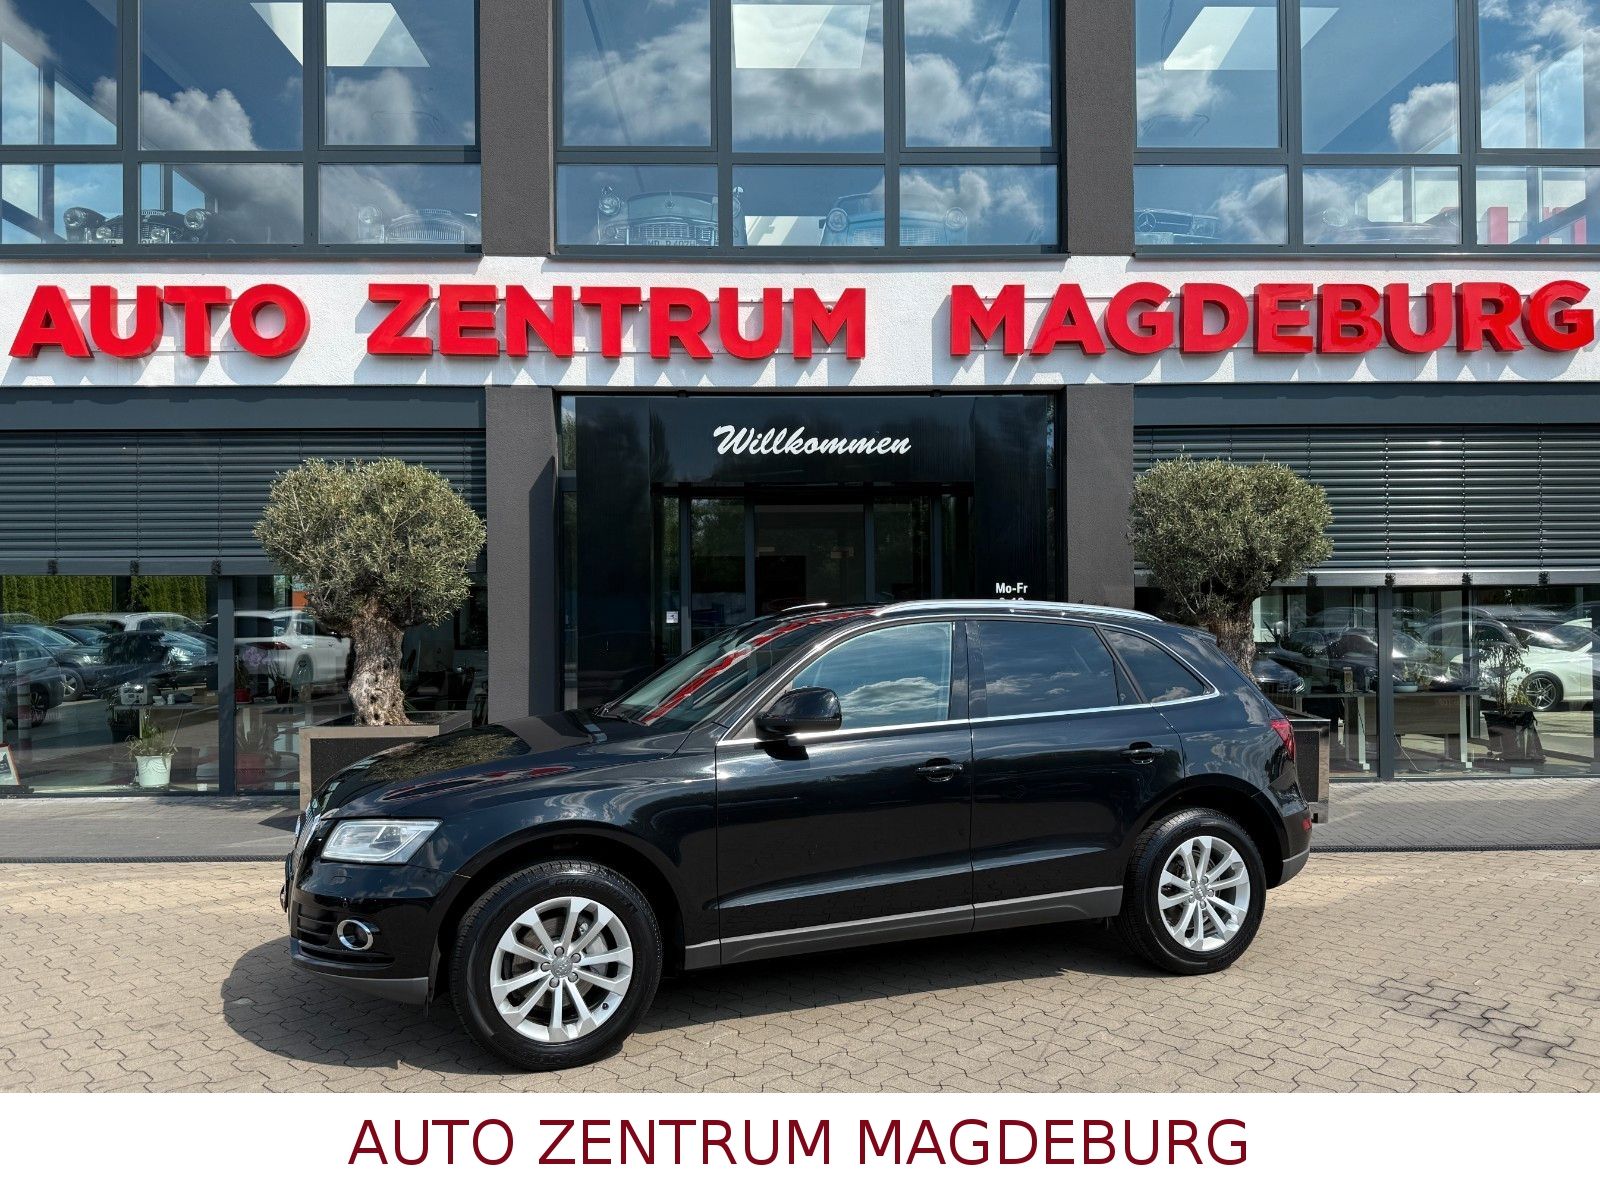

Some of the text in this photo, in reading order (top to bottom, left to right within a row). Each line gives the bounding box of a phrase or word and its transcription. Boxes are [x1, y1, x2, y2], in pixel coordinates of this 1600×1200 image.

[10, 280, 1596, 359] AUTO ZENTRUM MAGDEBURG
[713, 425, 912, 455] Willkommen
[995, 582, 1028, 594] Mo-Fr
